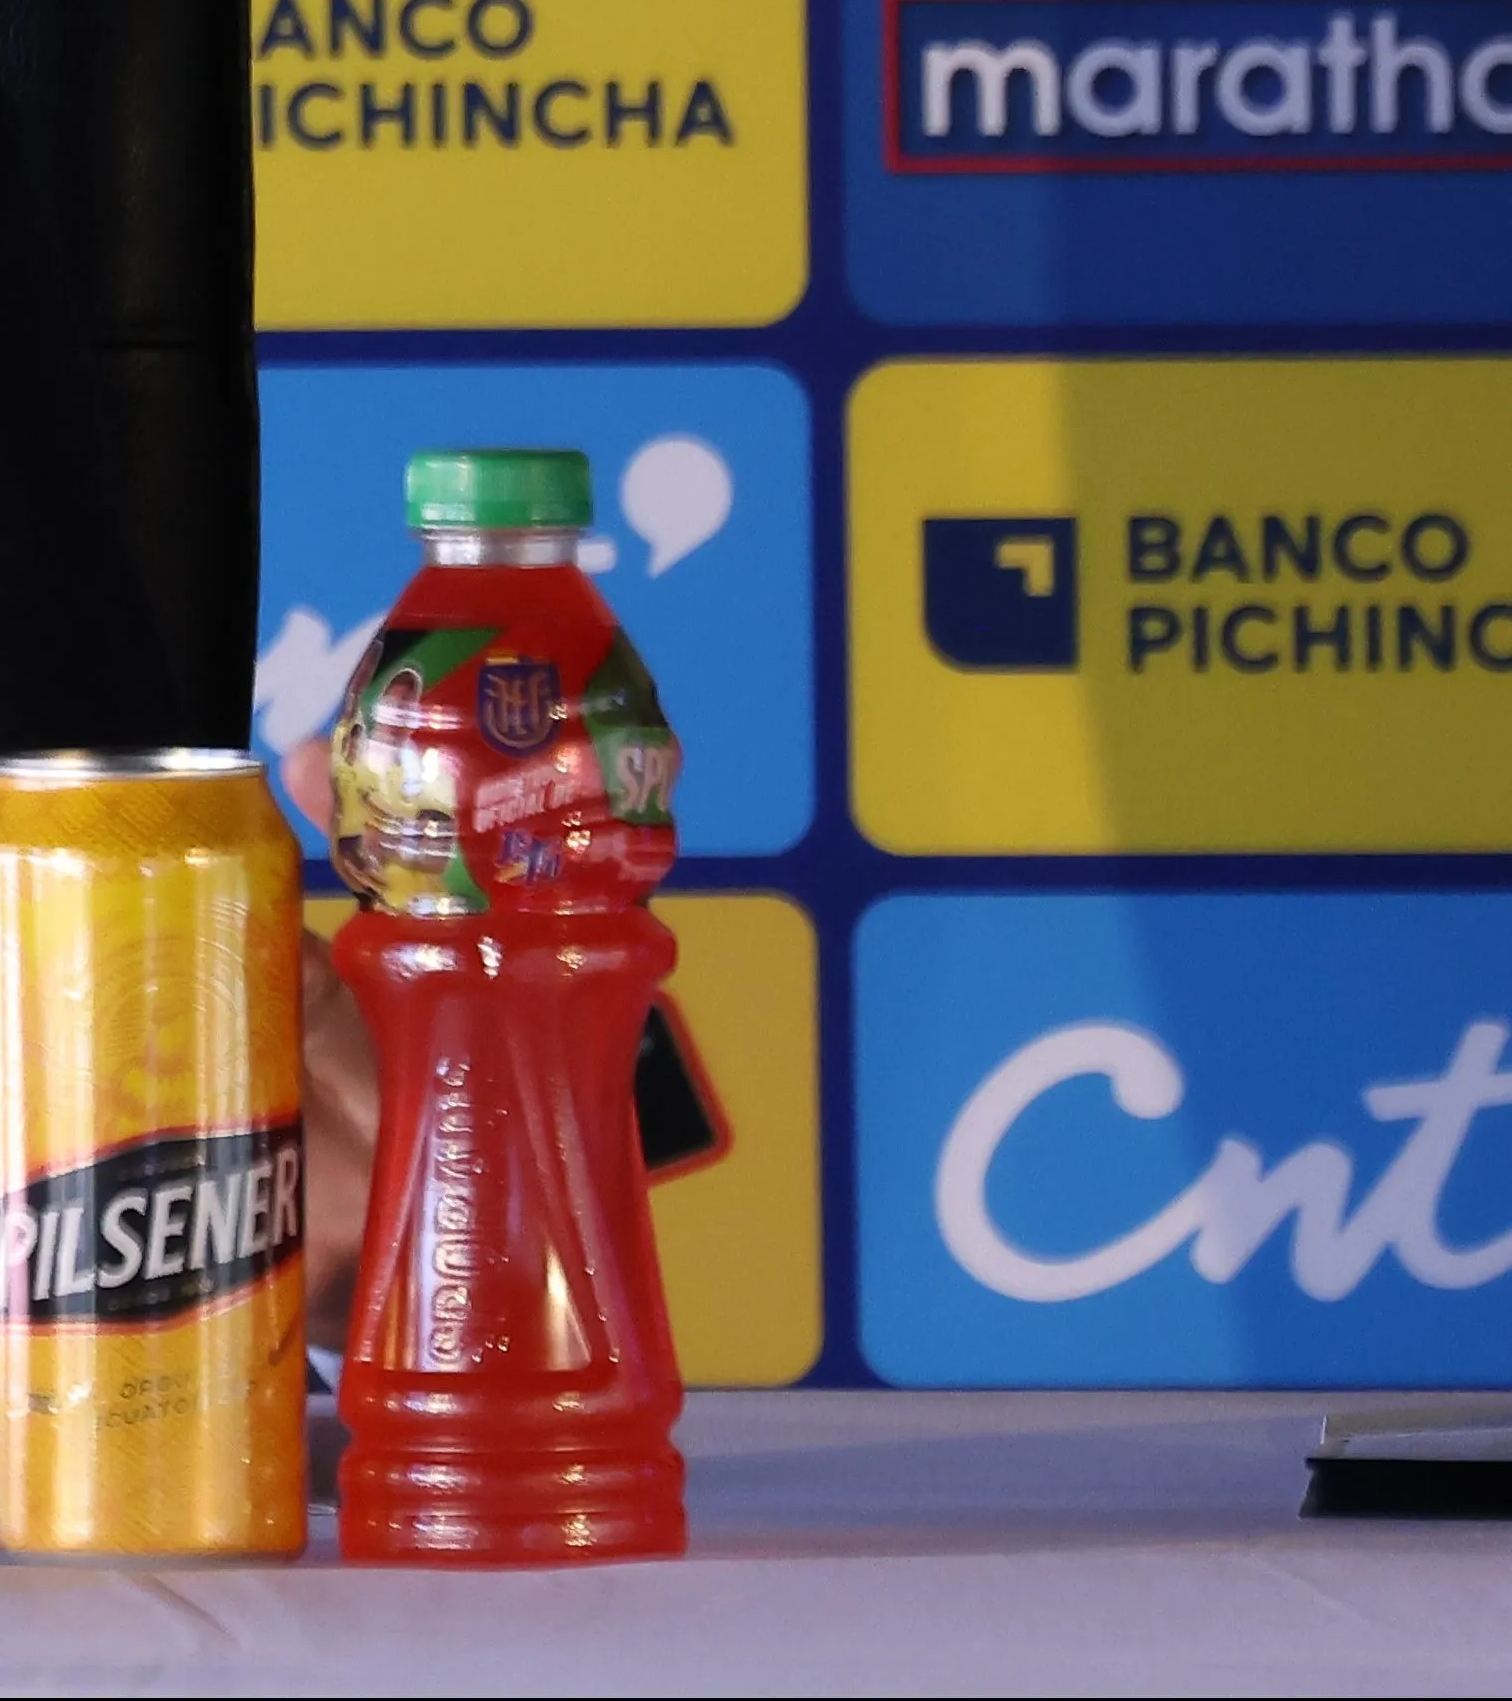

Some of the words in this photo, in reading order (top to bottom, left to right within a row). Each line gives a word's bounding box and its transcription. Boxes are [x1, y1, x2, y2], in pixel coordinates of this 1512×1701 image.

[921, 11, 1512, 137] maratho
[256, 77, 736, 152] ICHINCHA
[1127, 514, 1470, 584] BANCO
[1127, 604, 1512, 674] PICHINC
